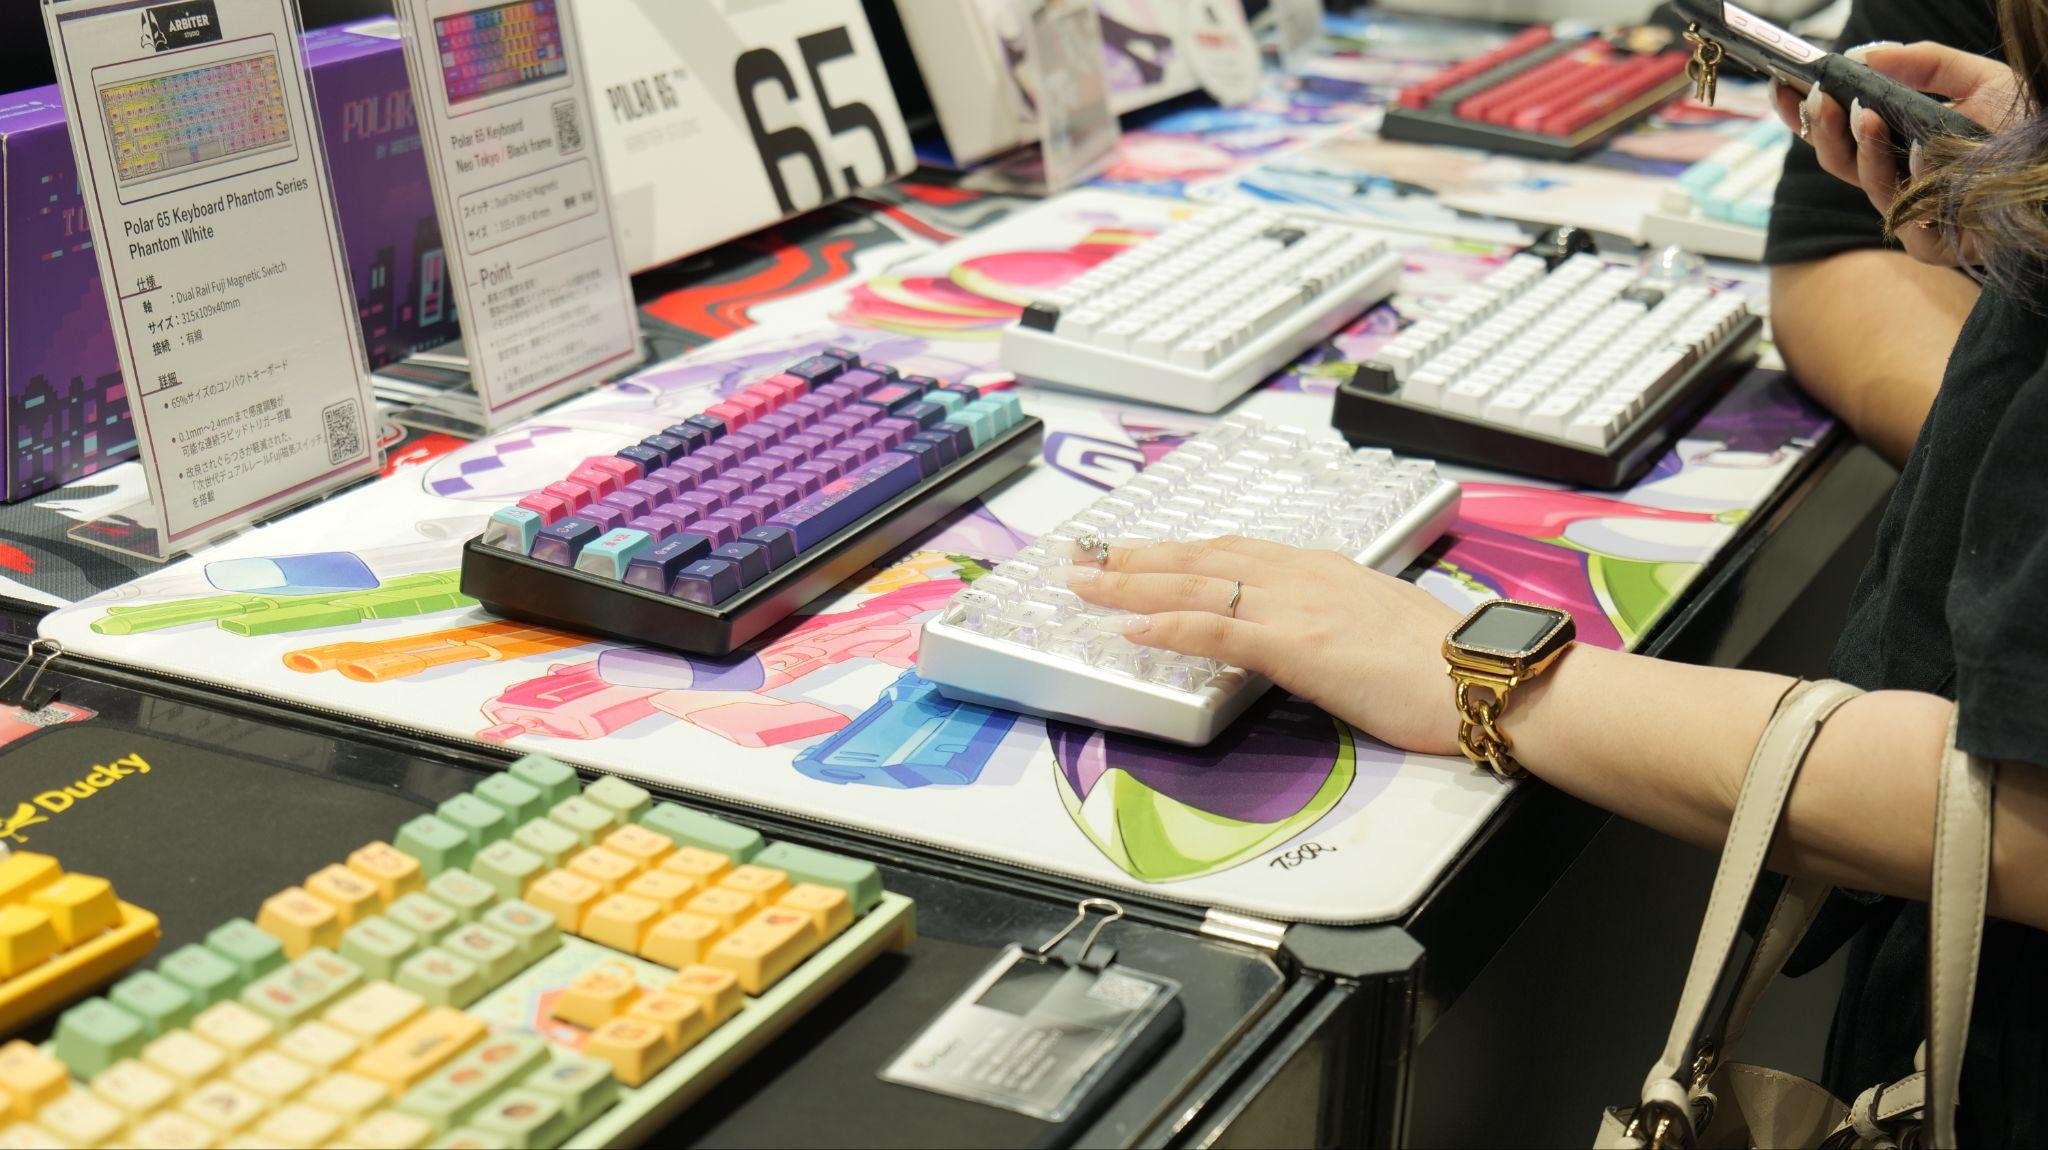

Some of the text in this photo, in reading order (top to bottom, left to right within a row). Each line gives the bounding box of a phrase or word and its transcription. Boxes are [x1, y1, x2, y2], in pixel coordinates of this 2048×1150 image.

[169, 11, 210, 32] ARBITER
[735, 26, 897, 218] 65
[456, 160, 474, 174] Neo
[124, 177, 309, 237] Polar 65 Keyboard Phantom Series
[129, 226, 214, 260] Phantom White
[136, 275, 157, 292] 仕様
[143, 299, 153, 313] 軸
[196, 284, 210, 298] Rail
[211, 279, 226, 296] Fuji
[227, 268, 262, 289] Magnetic
[261, 261, 288, 278] Switch
[480, 262, 513, 288] Point
[152, 340, 171, 357] 接続
[33, 753, 151, 814] Ducky
